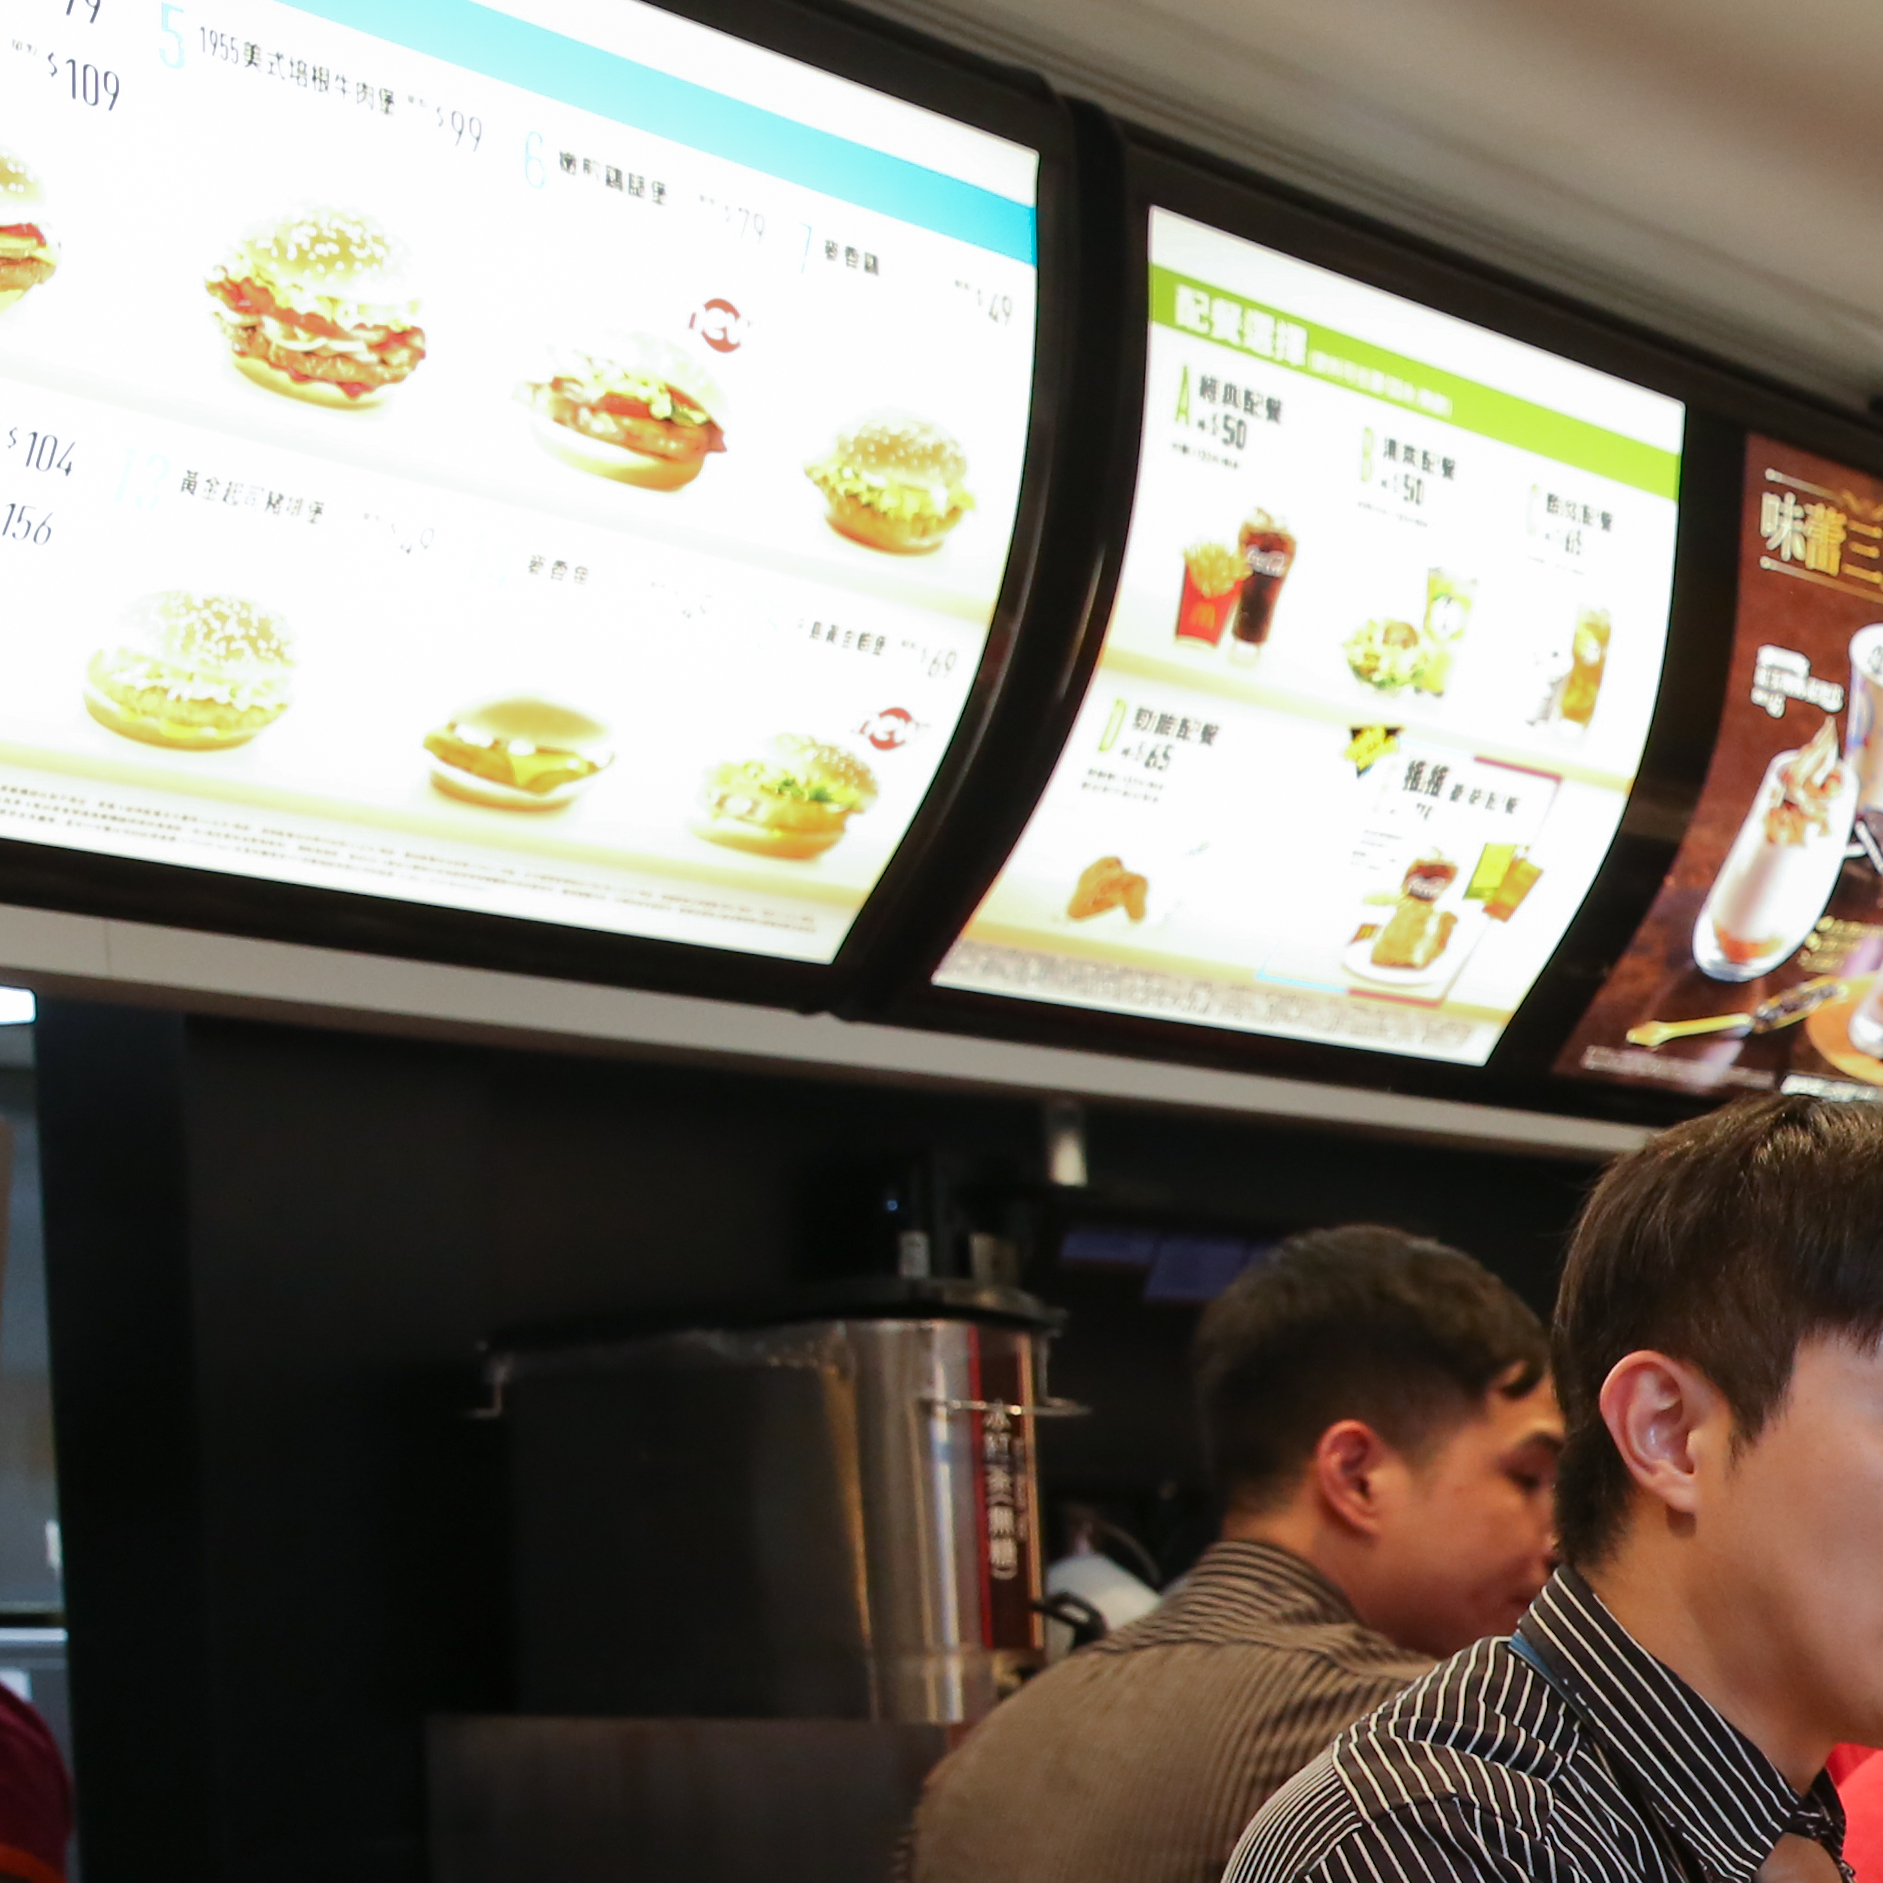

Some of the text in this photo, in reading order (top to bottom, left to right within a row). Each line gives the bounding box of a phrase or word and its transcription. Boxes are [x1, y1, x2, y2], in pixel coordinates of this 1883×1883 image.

[47, 52, 120, 111] $109
[199, 26, 396, 117] 1955美式培根牛肉堡
[523, 130, 546, 190] 6
[7, 426, 76, 476] $104
